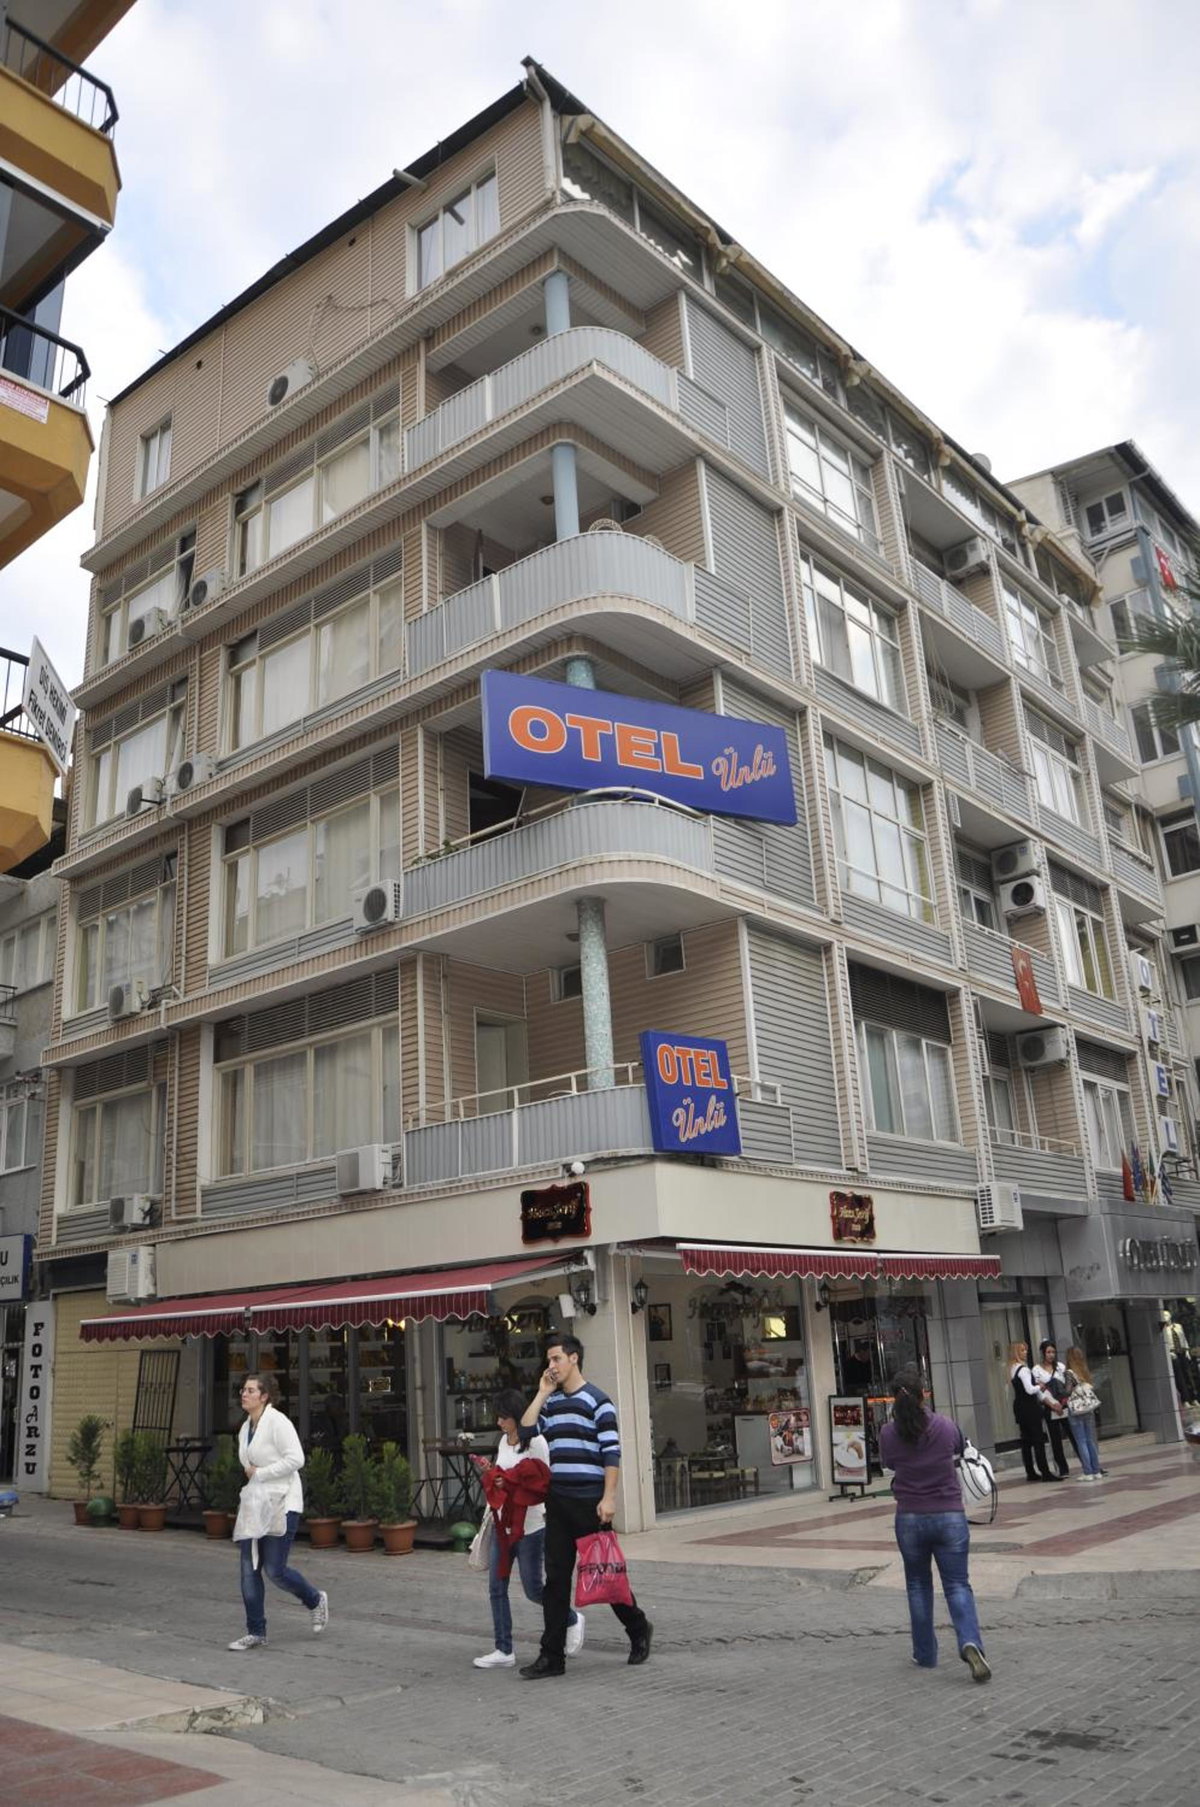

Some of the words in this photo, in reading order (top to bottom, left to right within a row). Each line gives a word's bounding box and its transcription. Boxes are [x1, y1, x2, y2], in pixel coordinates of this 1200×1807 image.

[28, 688, 46, 730] Fikret
[509, 705, 704, 780] OTEL
[711, 744, 777, 792] Ünlü
[657, 1043, 728, 1090] OTEL
[672, 1095, 727, 1142] Ünlü
